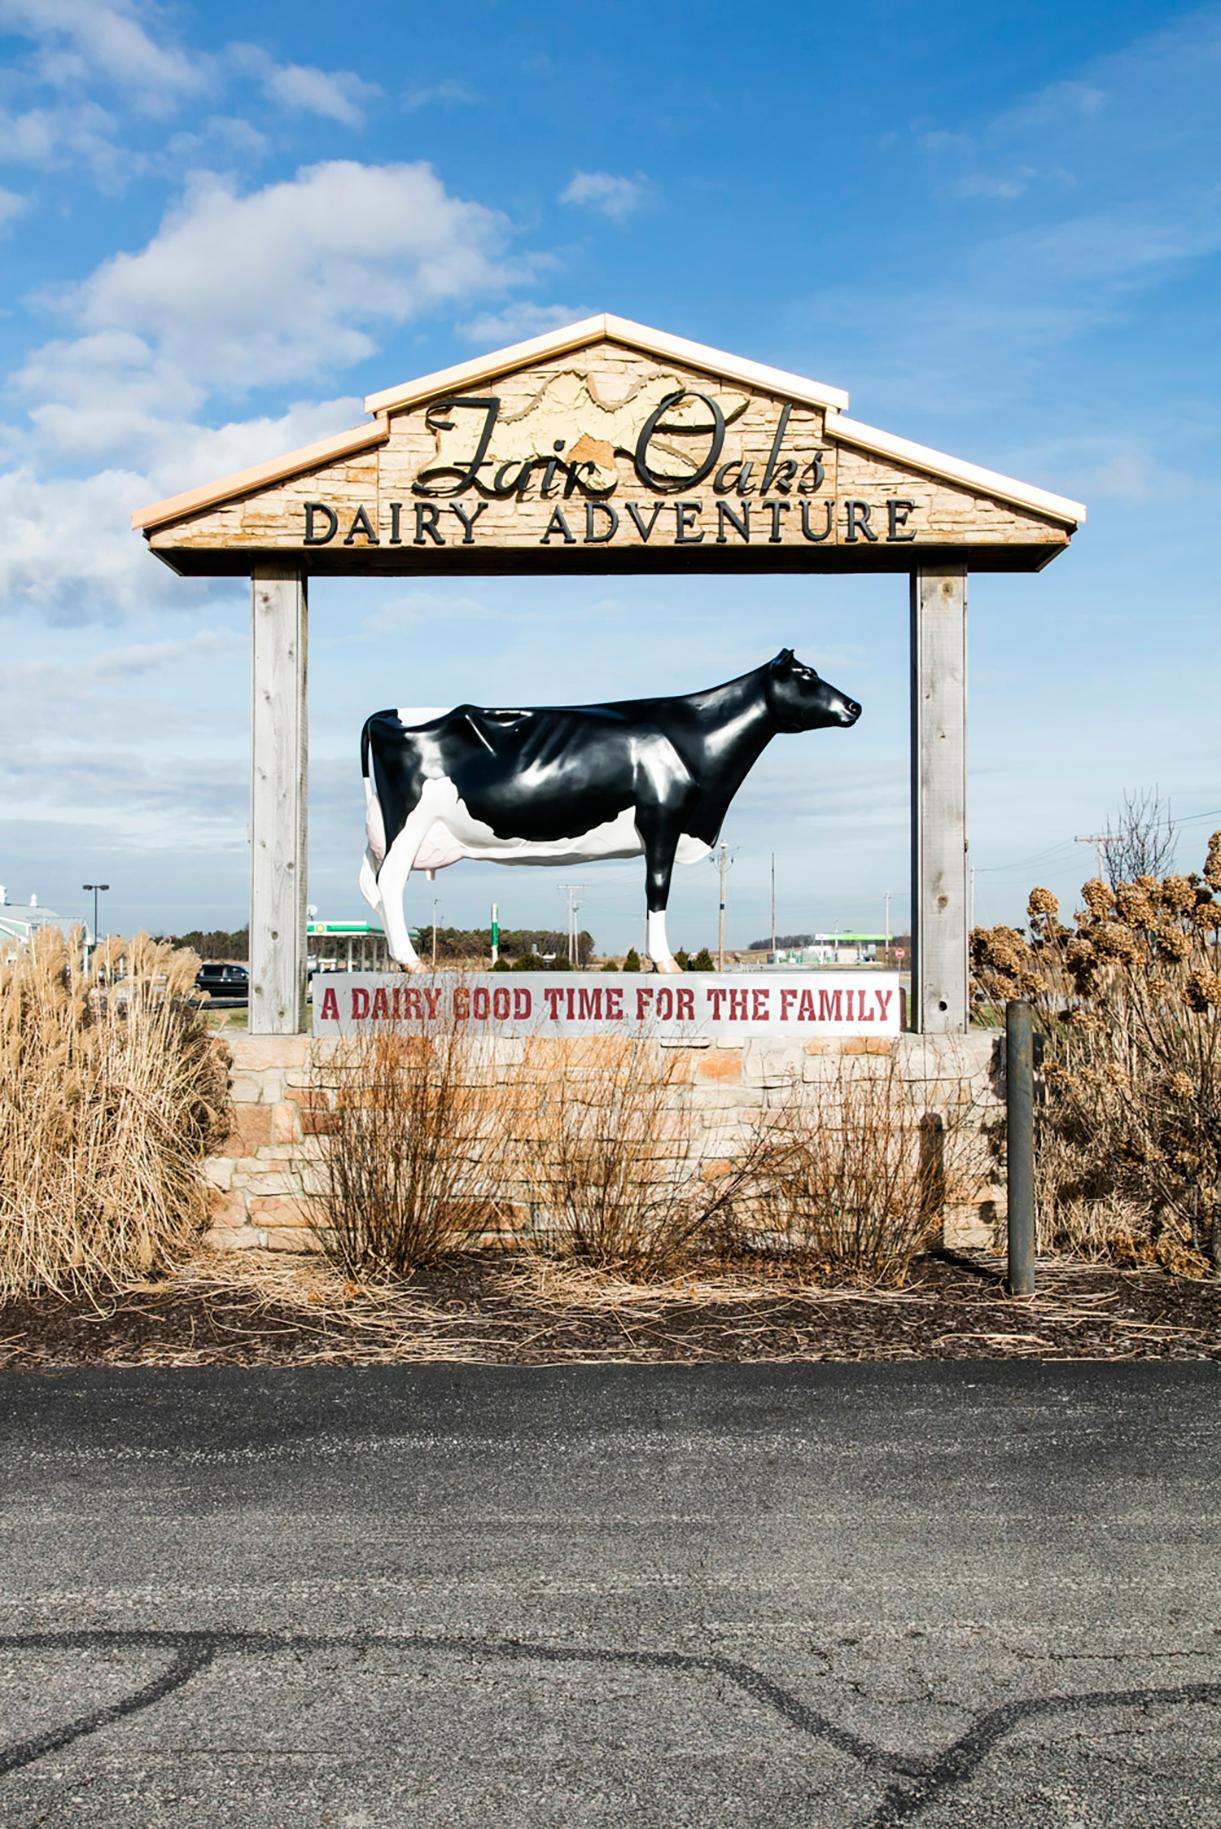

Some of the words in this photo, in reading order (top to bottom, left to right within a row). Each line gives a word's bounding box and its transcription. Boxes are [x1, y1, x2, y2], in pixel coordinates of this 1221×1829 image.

[412, 397, 597, 498] Fair
[634, 391, 826, 496] Oaks
[303, 502, 489, 545] DAIRY
[540, 499, 917, 545] ADVENTURE
[320, 987, 340, 1020] A
[351, 987, 442, 1020] DAIRY
[453, 987, 532, 1020] GOOD
[544, 987, 624, 1020] TIME
[636, 987, 695, 1021] FOR
[706, 988, 770, 1021] THE
[780, 988, 893, 1021] FAMILY
